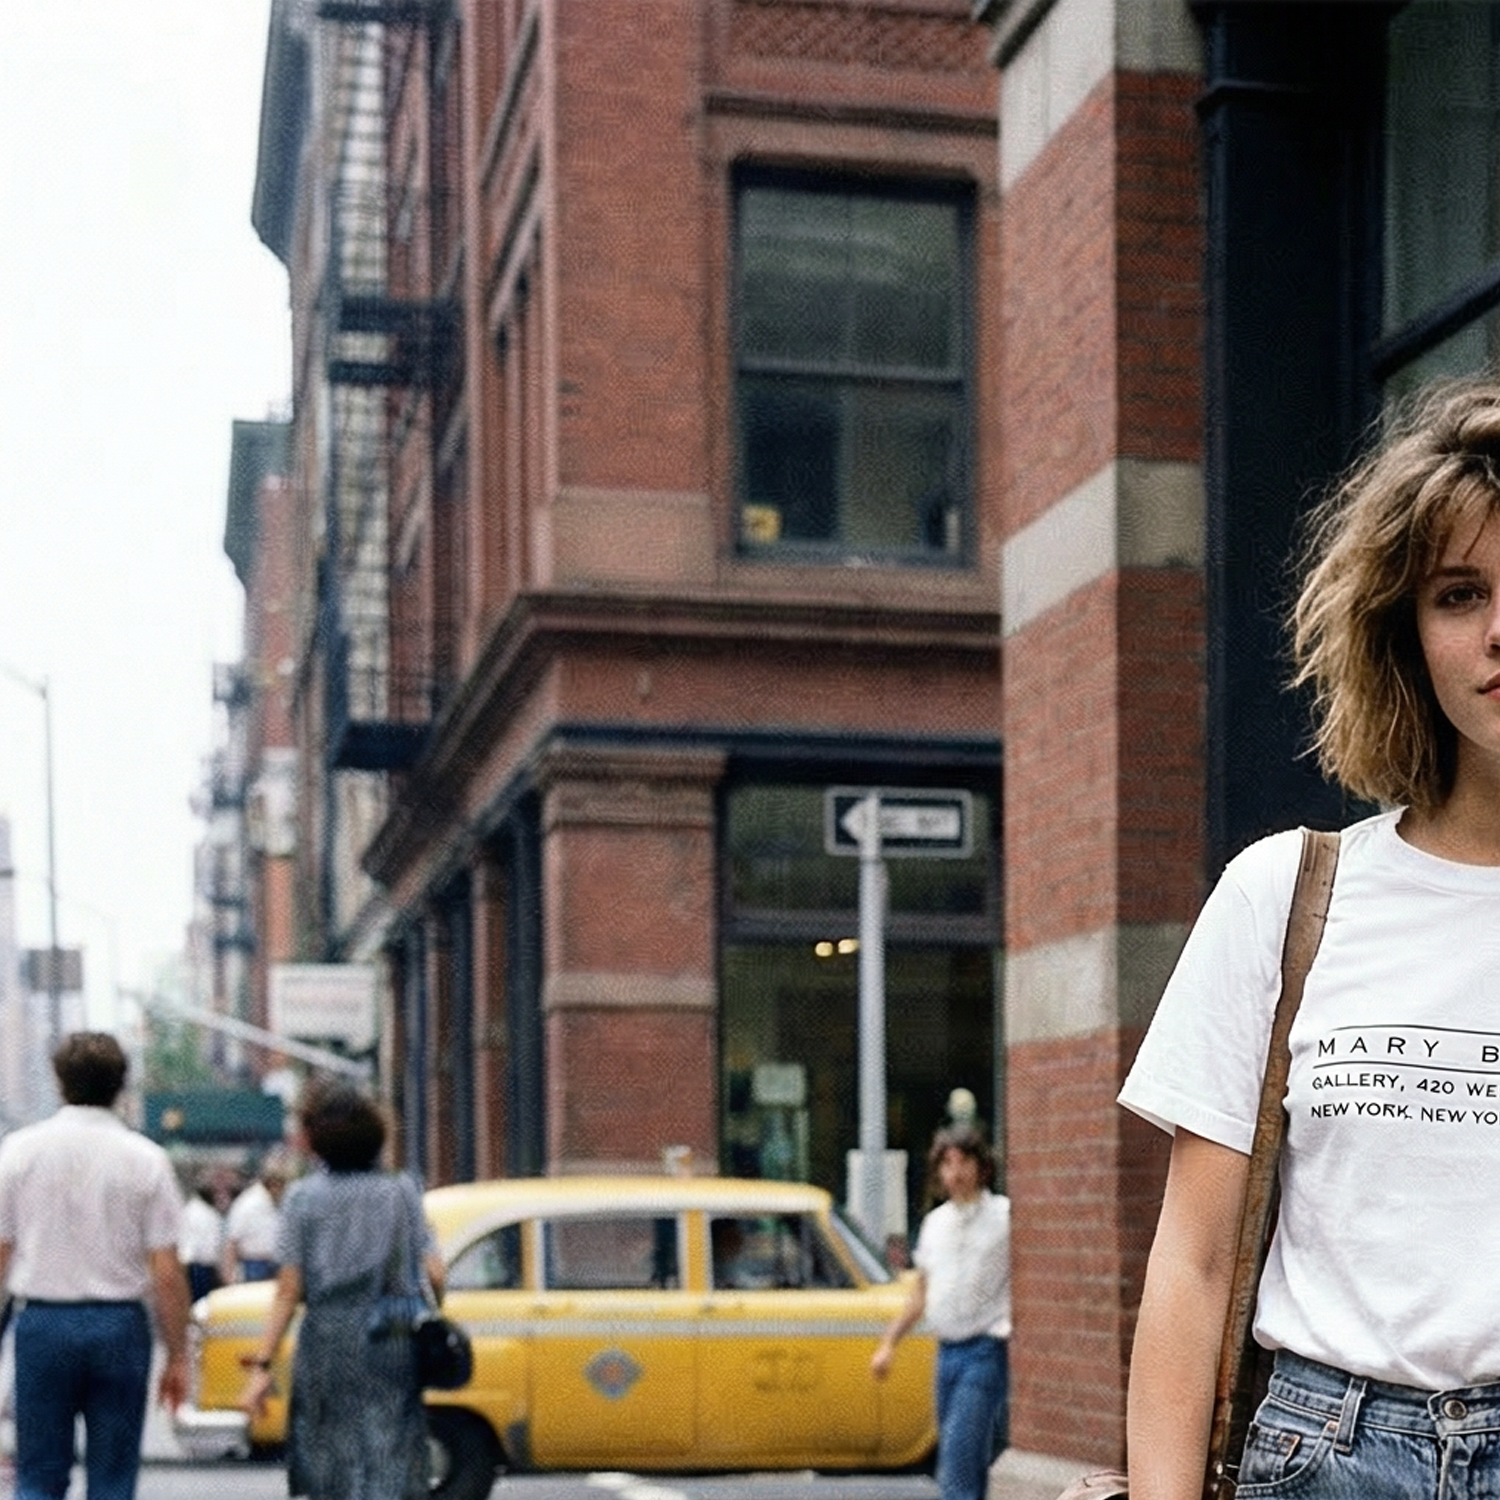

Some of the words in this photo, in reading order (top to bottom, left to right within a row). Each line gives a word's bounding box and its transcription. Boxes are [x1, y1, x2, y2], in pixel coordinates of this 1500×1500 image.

[1317, 1036, 1440, 1058] MARY
[1311, 1073, 1405, 1092] GALLERY,
[1416, 1078, 1455, 1095] 420
[1311, 1102, 1350, 1119] NEW
[1421, 1107, 1467, 1124] NEW
